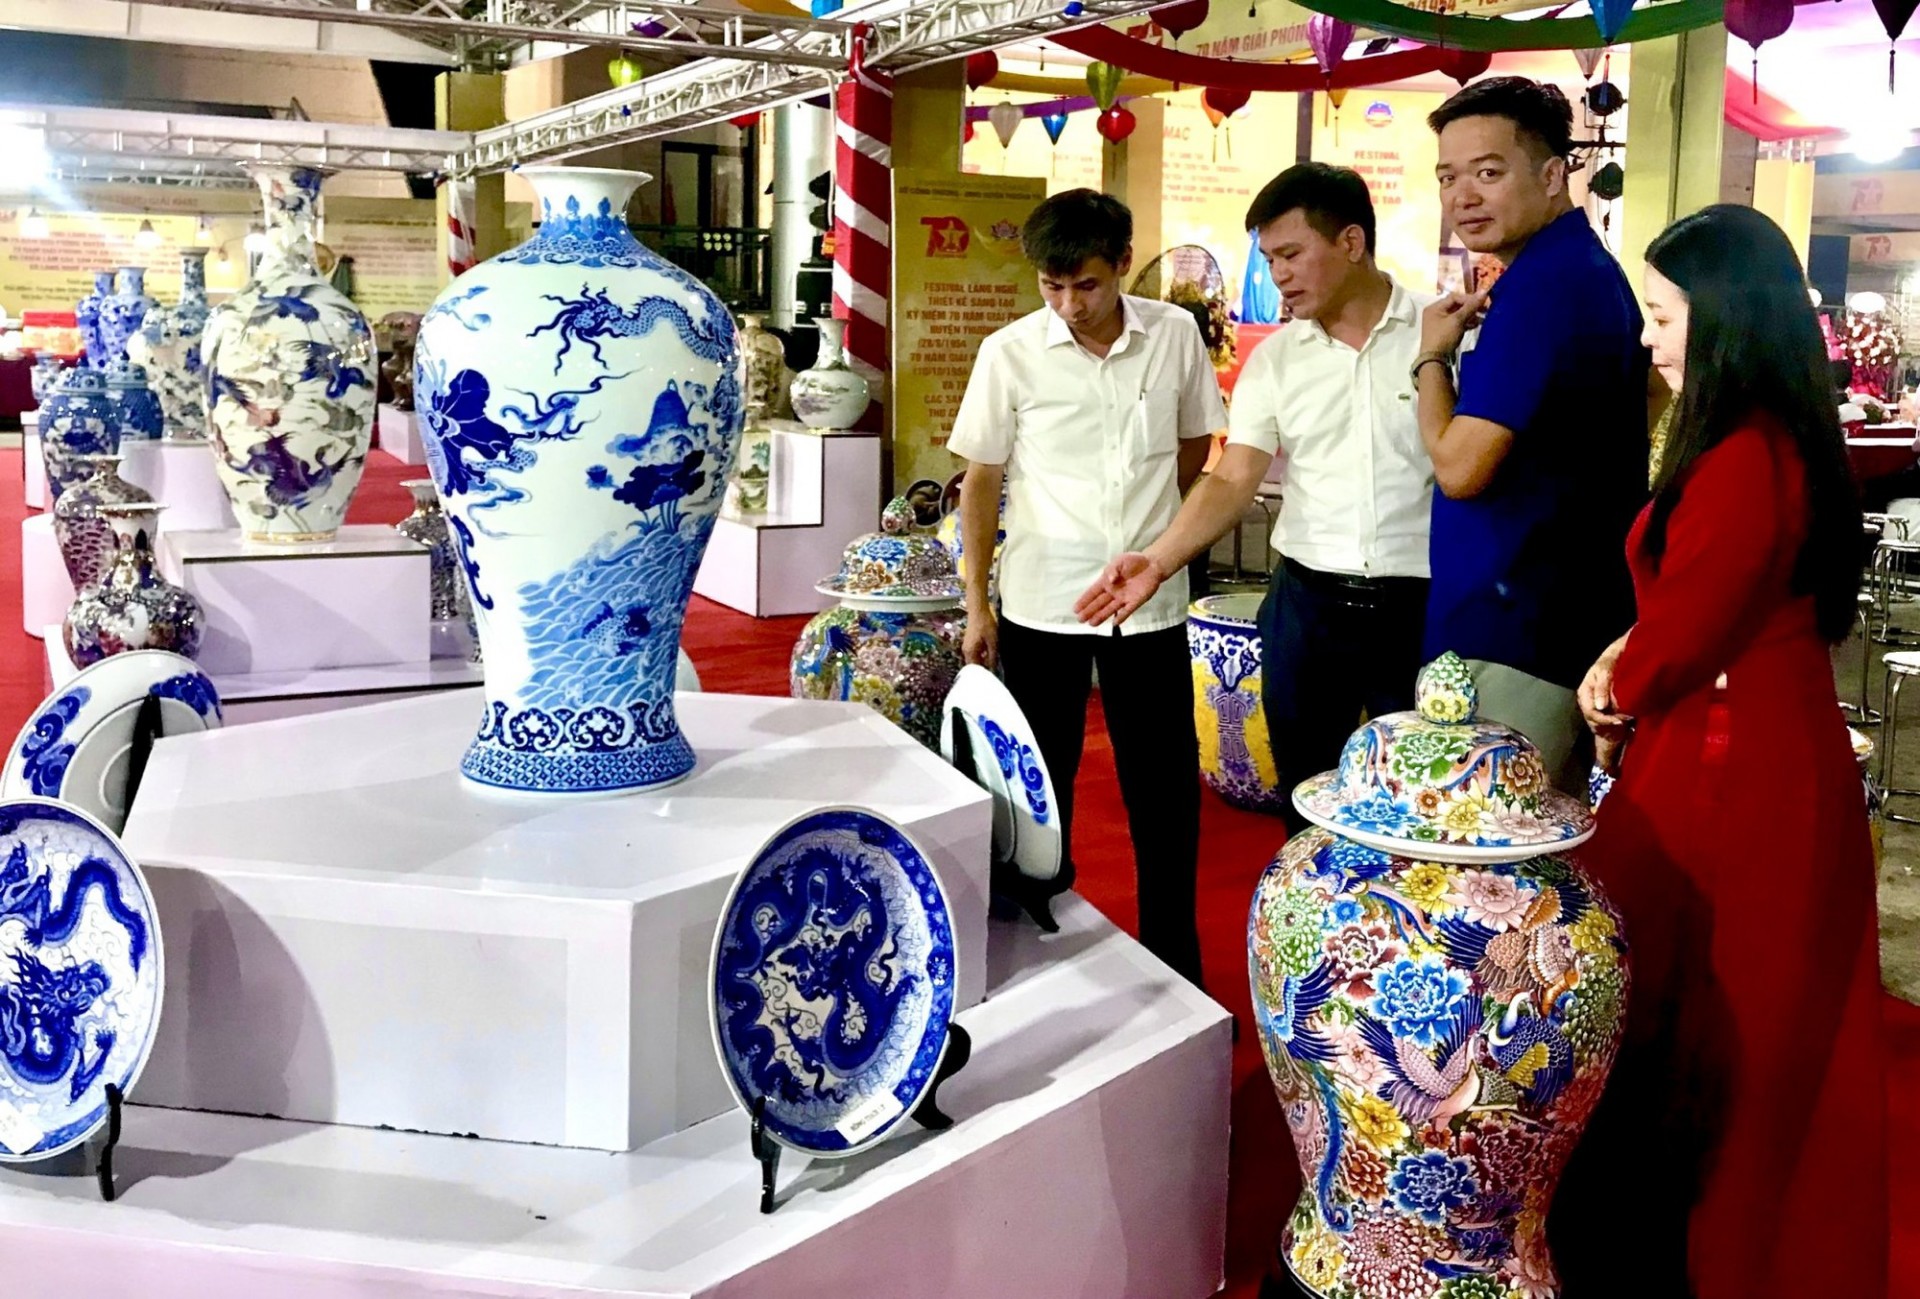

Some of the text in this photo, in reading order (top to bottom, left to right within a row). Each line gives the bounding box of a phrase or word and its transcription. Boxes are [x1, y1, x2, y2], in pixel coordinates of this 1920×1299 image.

[1270, 22, 1308, 47] PHÓN
[1354, 150, 1400, 160] FESTIVAL
[924, 282, 965, 293] FESTIVAL
